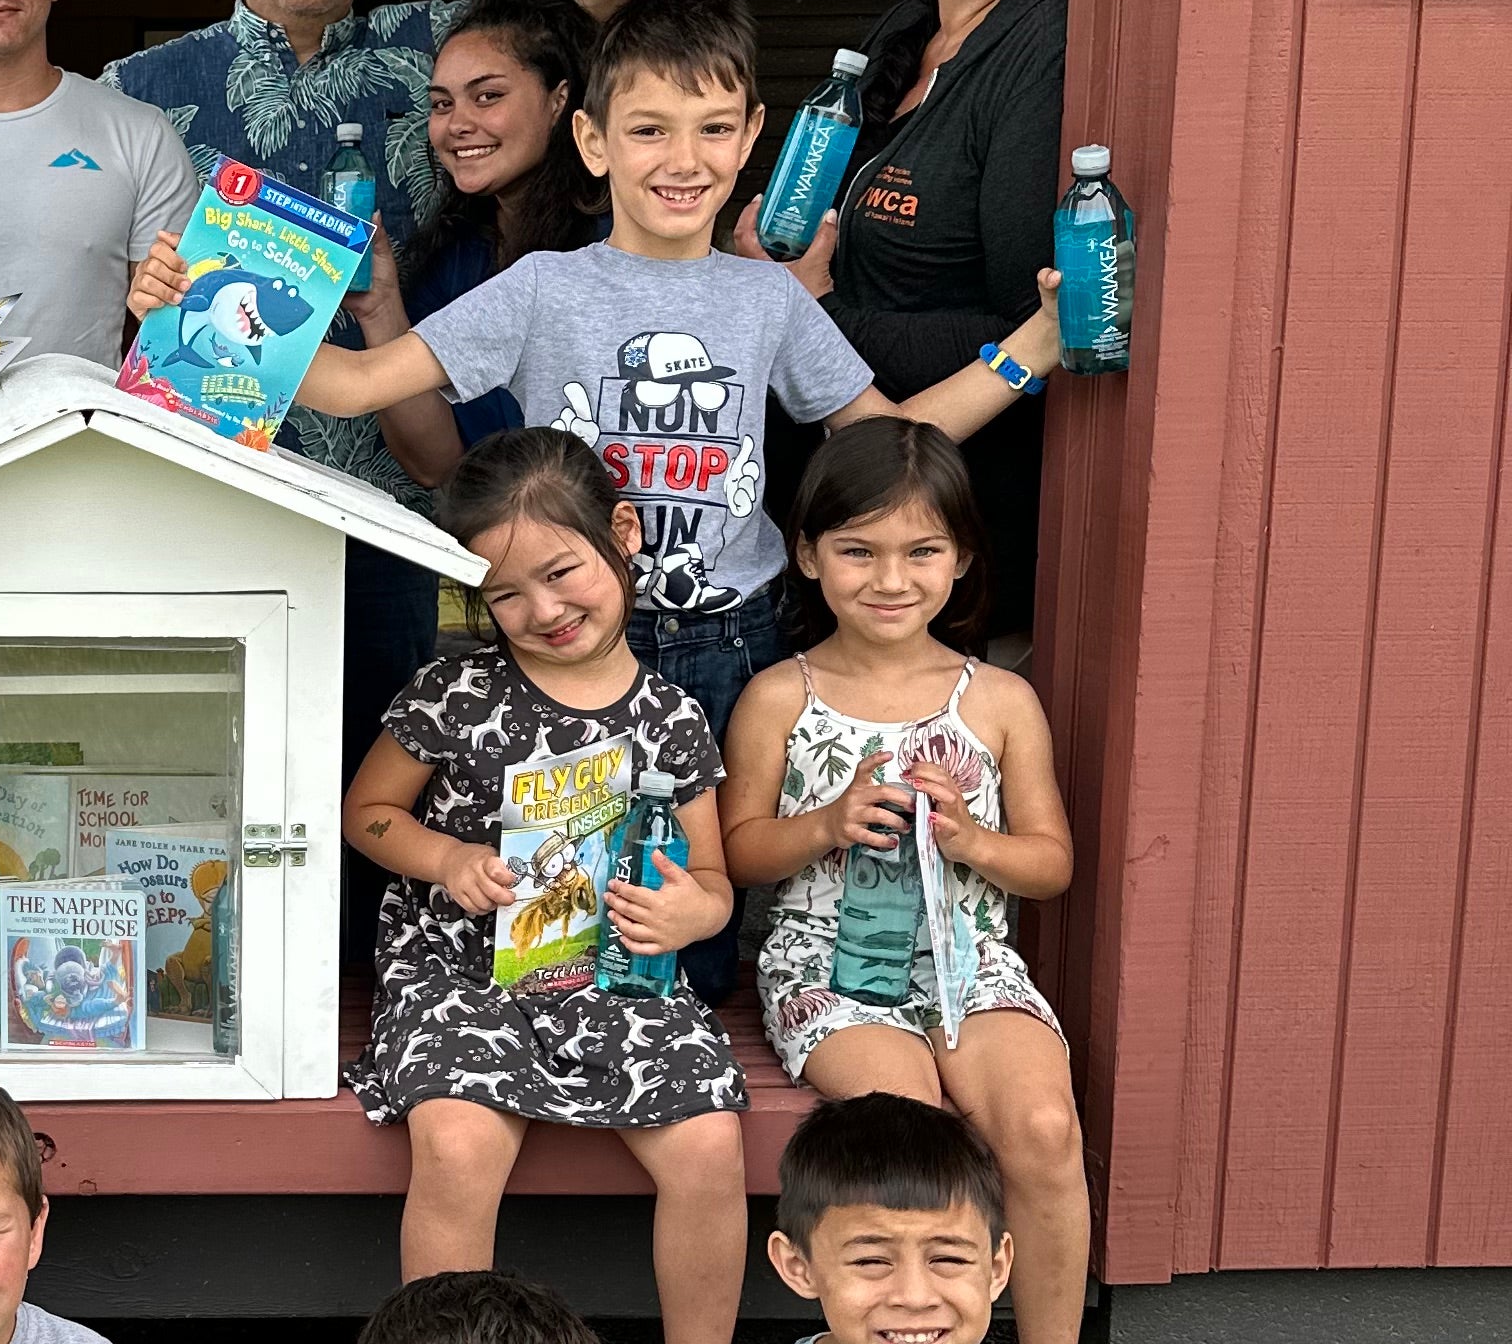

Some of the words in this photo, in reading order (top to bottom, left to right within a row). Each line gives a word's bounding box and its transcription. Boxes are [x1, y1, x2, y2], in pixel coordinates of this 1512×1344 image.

[791, 125, 834, 201] WAIAKEA
[234, 175, 247, 194] 1
[265, 188, 291, 208] STEP
[290, 202, 308, 215] INTO
[306, 207, 355, 236] READING
[205, 207, 232, 231] Big
[279, 226, 311, 254] Little
[311, 247, 344, 284] Shark
[228, 230, 248, 250] Go
[251, 240, 263, 251] to
[263, 241, 317, 282] School
[1099, 234, 1118, 323] WAIAKEA
[664, 356, 707, 373] SKATE
[602, 442, 730, 492] STOP
[643, 506, 704, 555] UN
[512, 764, 572, 805] FLY
[574, 745, 625, 790] GUY
[31, 801, 47, 813] of
[77, 788, 116, 807] TIME
[123, 790, 149, 806] FOR
[571, 798, 624, 837] INSECTS
[115, 839, 137, 847] JANE
[140, 841, 169, 850] YOLEN
[179, 844, 205, 854] MARK
[156, 854, 179, 871] Do
[139, 874, 188, 889] osaurs
[7, 895, 46, 914] THE
[52, 897, 138, 917] NAPPING
[160, 889, 176, 904] to
[147, 907, 187, 927] EEP?
[72, 919, 138, 936] HOUSE
[536, 967, 566, 980] Tedd
[569, 963, 596, 977] Arno
